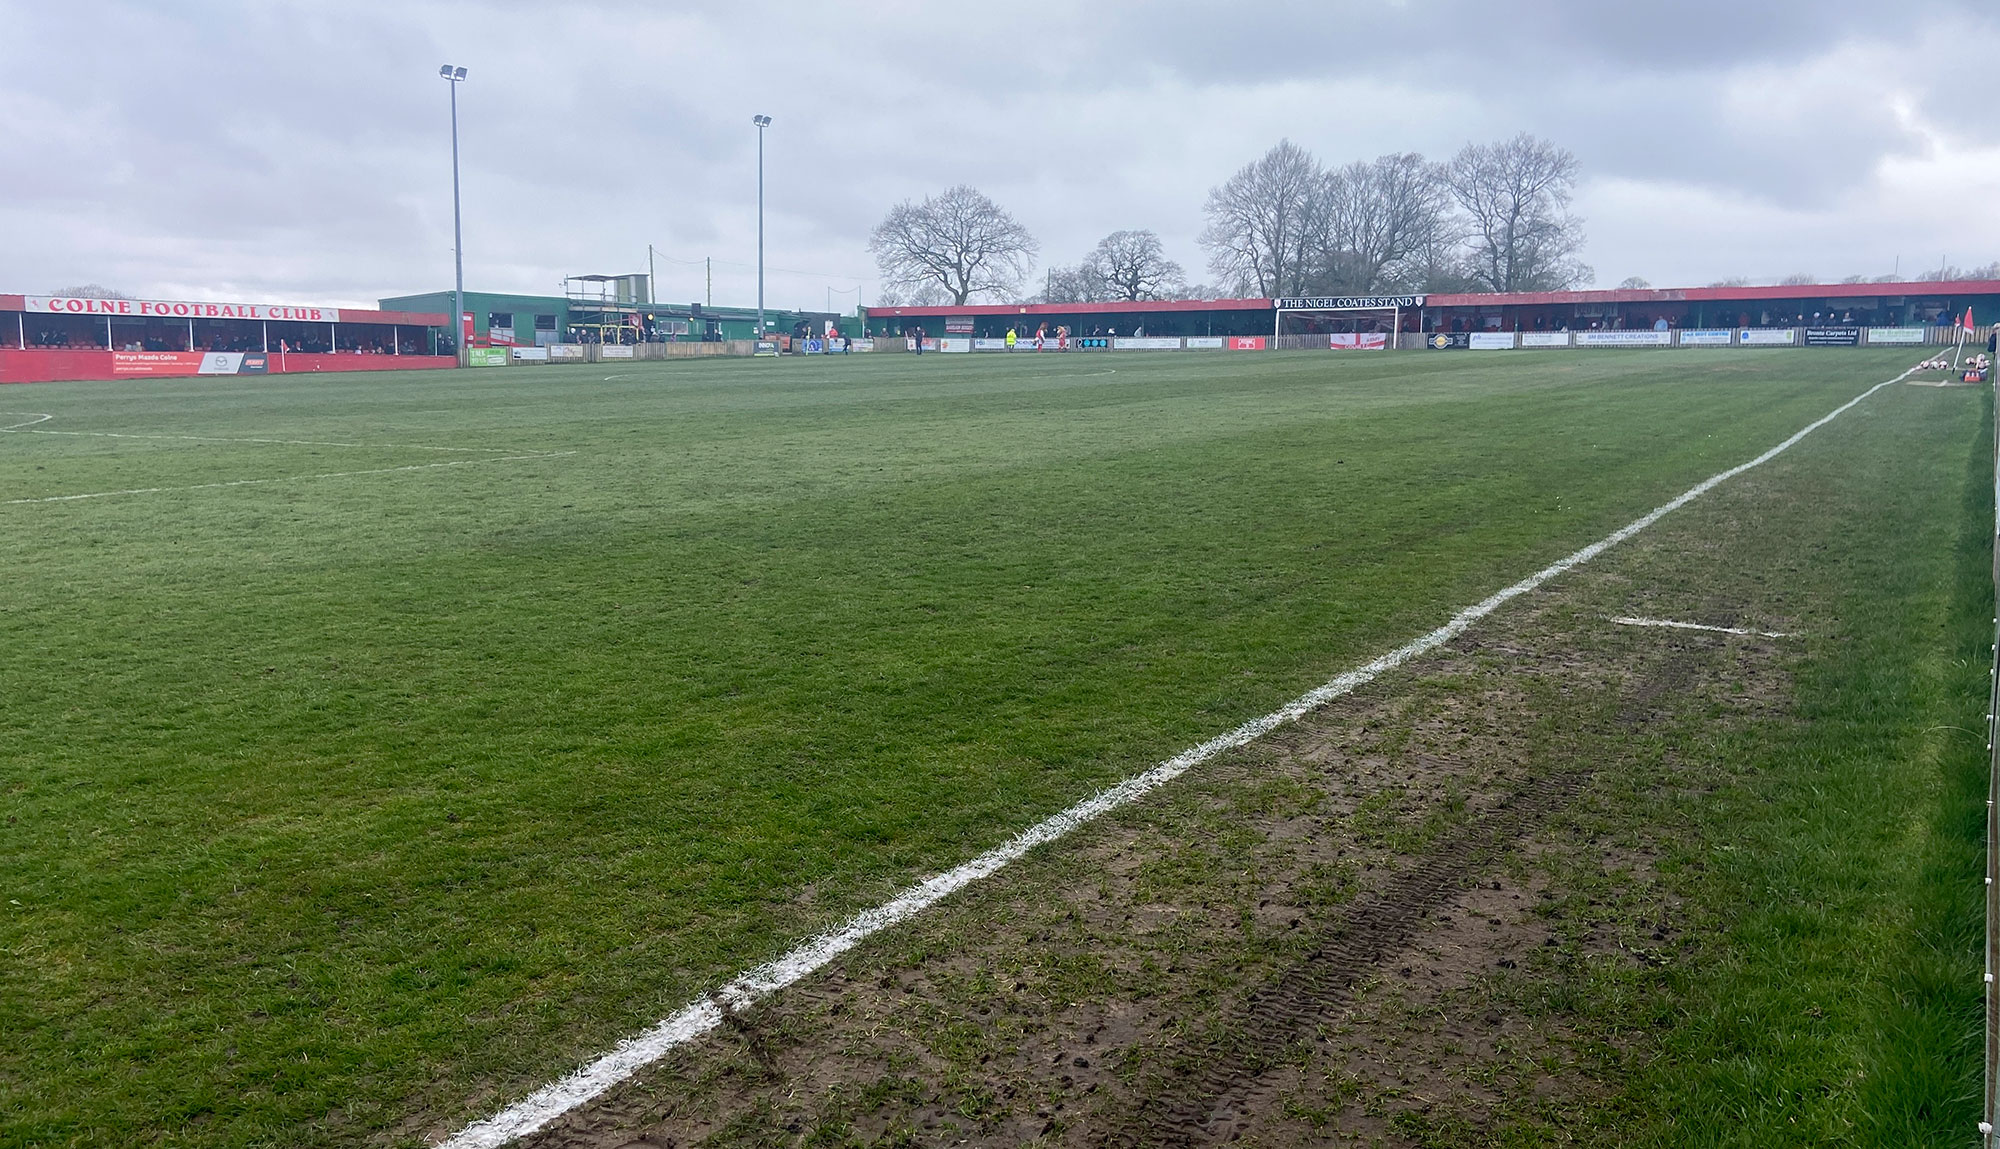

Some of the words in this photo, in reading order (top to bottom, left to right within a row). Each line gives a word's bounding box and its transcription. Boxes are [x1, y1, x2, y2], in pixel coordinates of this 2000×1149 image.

[48, 299, 131, 313] COLNE
[140, 302, 261, 318] FOOTBALL
[268, 307, 322, 320] CLUB
[1283, 299, 1304, 308] THE
[1305, 299, 1336, 308] NIGEL
[1337, 298, 1376, 307] COATES
[1377, 297, 1413, 307] STAND
